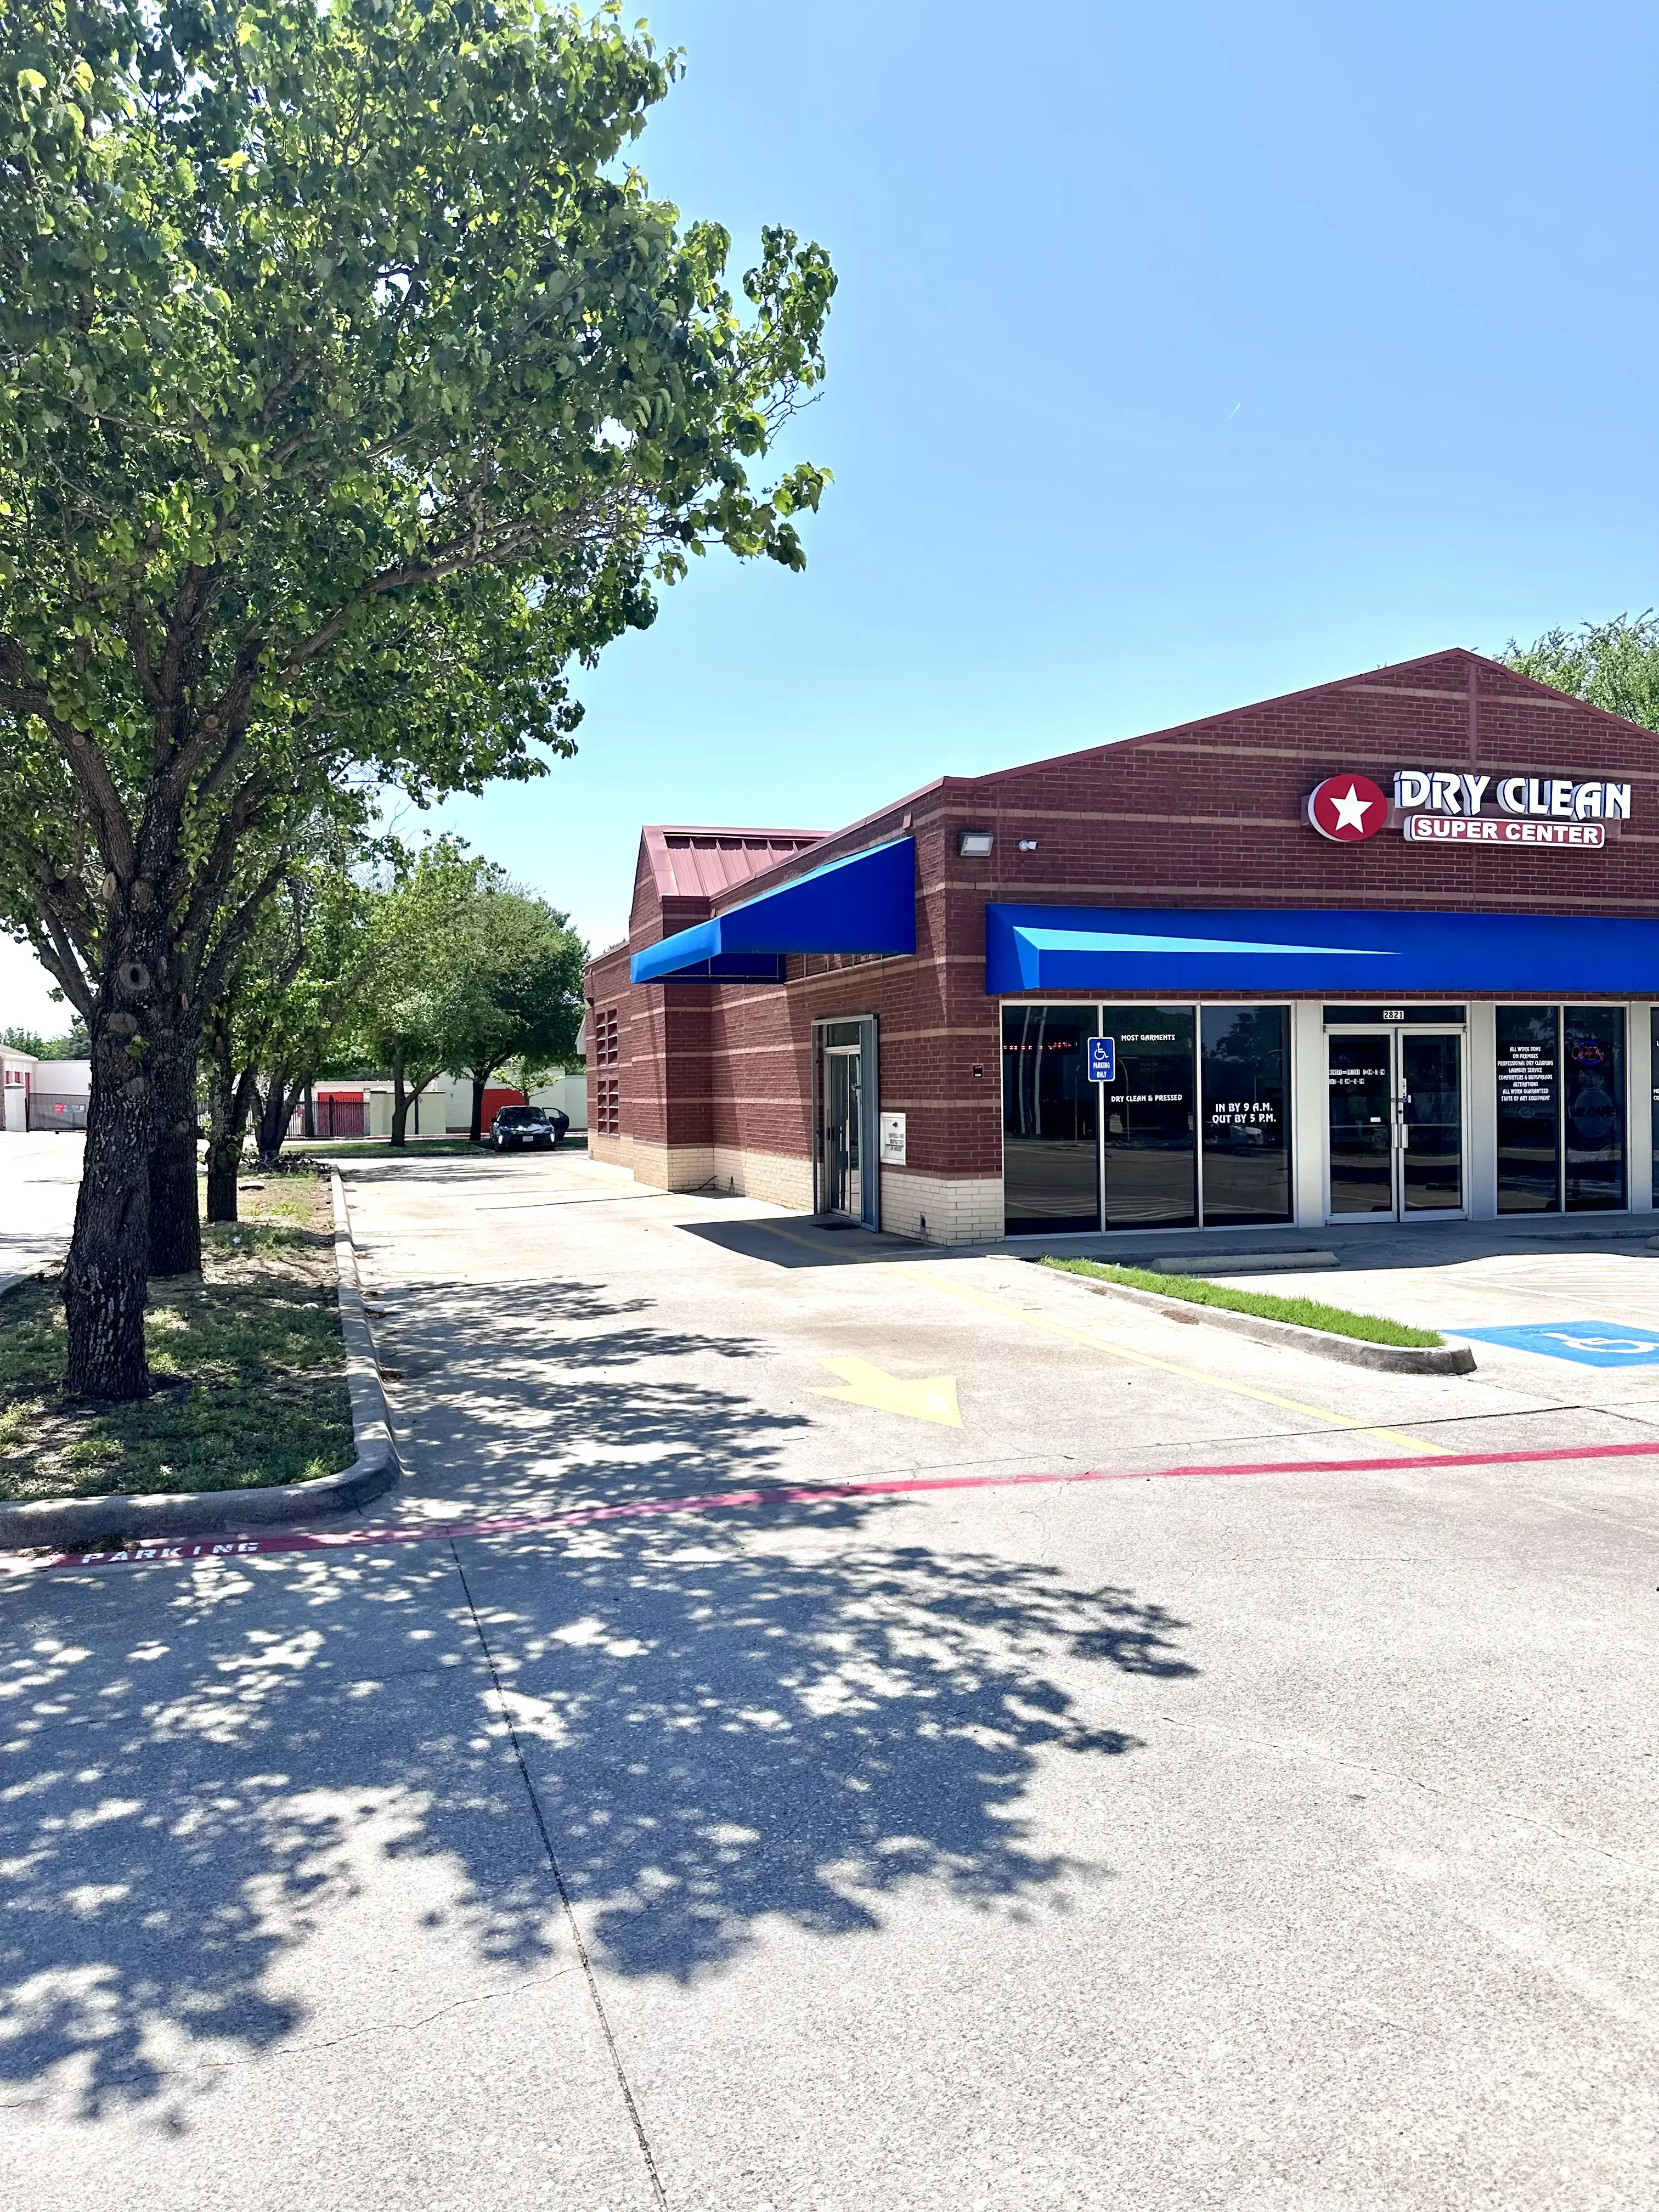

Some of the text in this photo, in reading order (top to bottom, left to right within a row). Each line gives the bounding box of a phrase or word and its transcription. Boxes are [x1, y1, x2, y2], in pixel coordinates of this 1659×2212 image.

[1392, 770, 1632, 821] DRY CLEAN
[1417, 819, 1599, 844] SUPER CENTER
[1215, 1102, 1273, 1112] IN BY 9 A.M.
[1212, 1113, 1277, 1124] OUT BY 5 P.M.
[81, 1542, 259, 1564] PARKING
